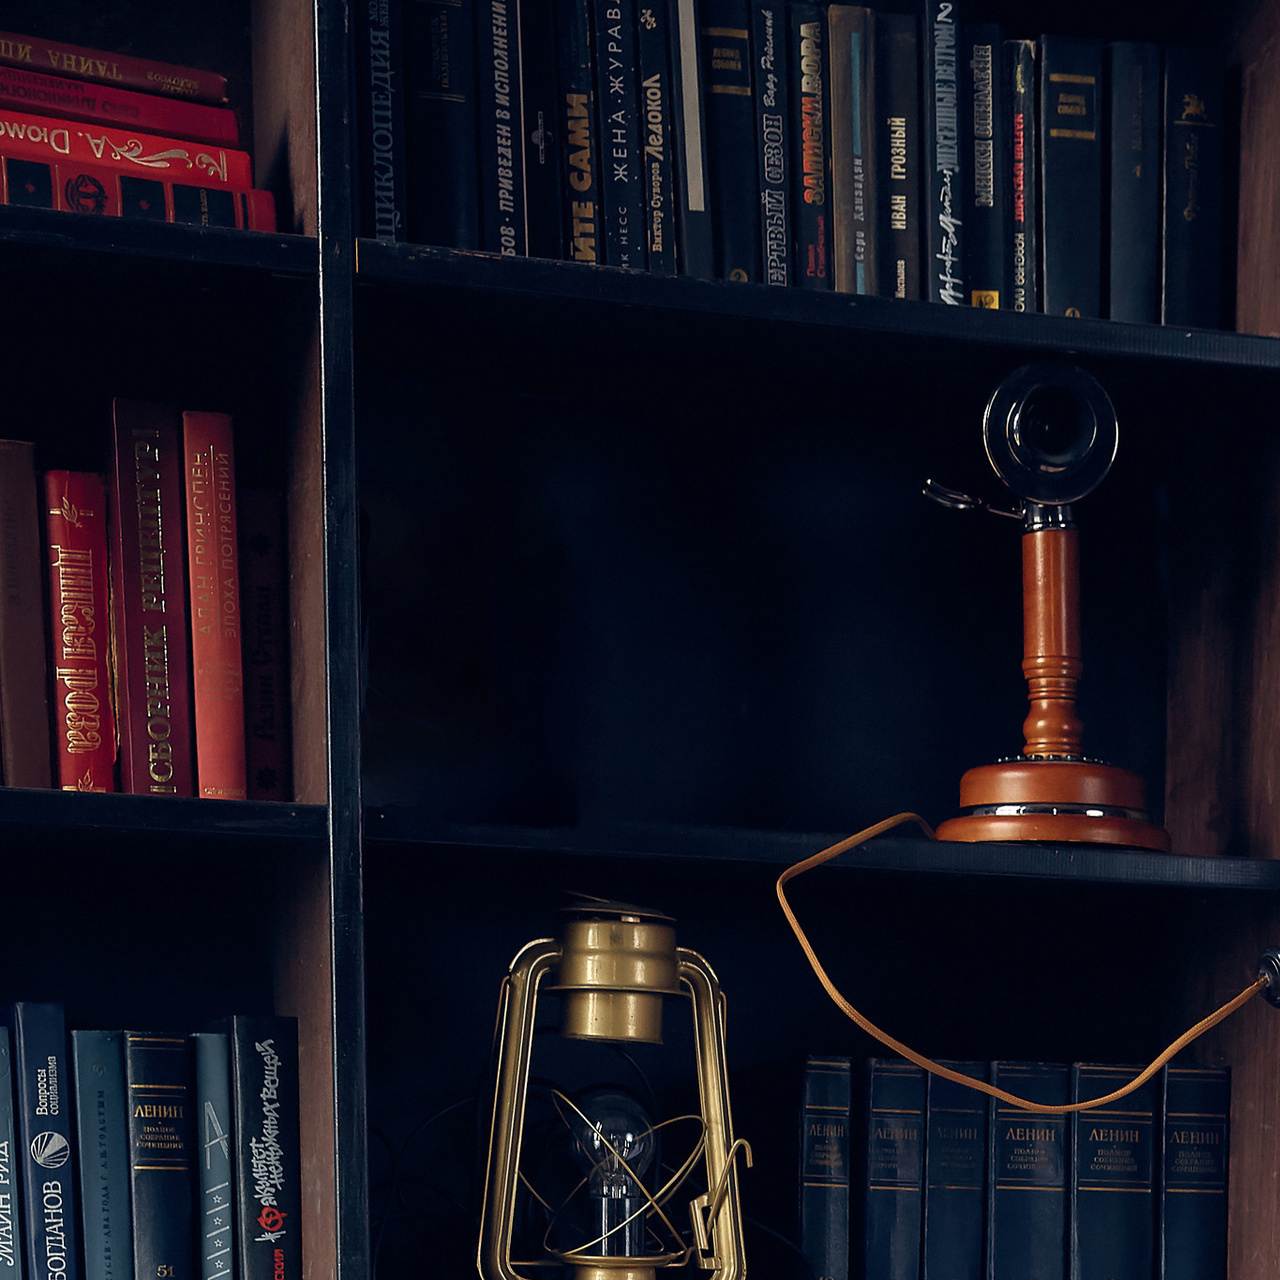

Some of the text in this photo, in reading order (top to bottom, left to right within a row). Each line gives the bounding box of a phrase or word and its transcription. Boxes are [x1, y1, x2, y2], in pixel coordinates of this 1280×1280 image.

[566, 93, 592, 192] САМИ
[800, 21, 824, 205] ЗАПИСКИ ВОРА
[497, 110, 515, 212] ПРИВЕДЕН В
[611, 110, 630, 244] НЕСС ЖЕНА
[643, 73, 664, 252] Виктор Суворов Ледокол
[763, 114, 783, 183] СЕЗОН
[886, 117, 907, 230] ИВАН ГРОЗНЫЙ
[191, 452, 215, 634] АЛАН ГРИНСПЕН
[216, 452, 237, 638] ЭПОХА ПОТРЯСЕНИЙ
[134, 440, 174, 782] СБОРНИК РЕЦЕПТУР
[36, 1068, 50, 1116] Вопросы
[46, 1055, 61, 1116] социализма
[133, 1104, 183, 1117] ЛЕНИН
[809, 1122, 845, 1139] ЛЕНИН
[874, 1126, 918, 1142] ЛЕНИН
[1005, 1127, 1056, 1142] ЛЕНИН
[1088, 1127, 1140, 1143] ЛЕНИН
[1170, 1130, 1220, 1145] ЛЕНИН
[156, 1264, 176, 1278] 51
